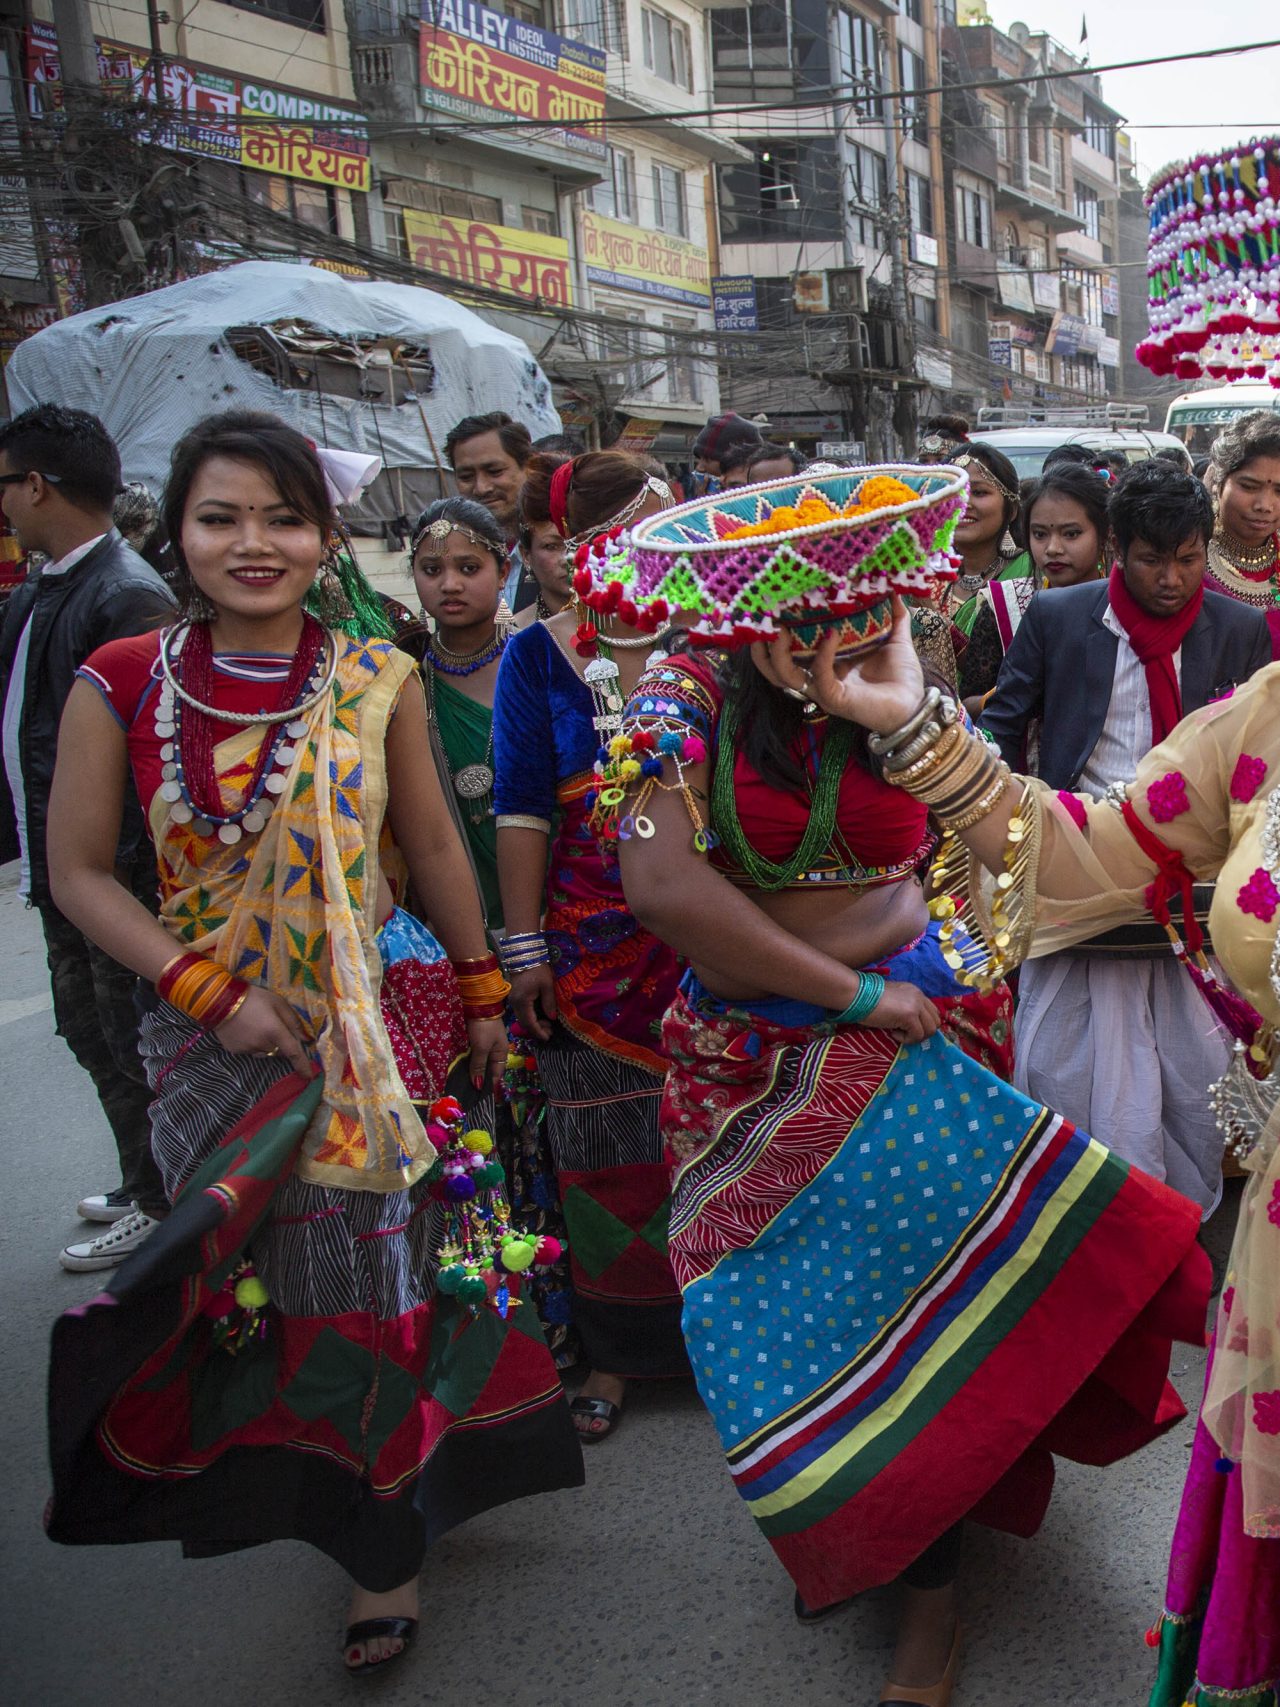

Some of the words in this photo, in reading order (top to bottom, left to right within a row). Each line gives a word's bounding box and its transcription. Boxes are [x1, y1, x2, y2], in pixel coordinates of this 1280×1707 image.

[427, 0, 509, 51] VALLEY
[515, 24, 546, 49] IDEOL
[508, 37, 557, 69] INSTITUTE
[426, 36, 540, 119] कोरियन
[424, 88, 470, 115] ENGLISH
[244, 123, 367, 187] कोरियन
[411, 219, 568, 308] कोरियन
[637, 233, 681, 279] कोरियन
[716, 314, 757, 330] कोरियन
